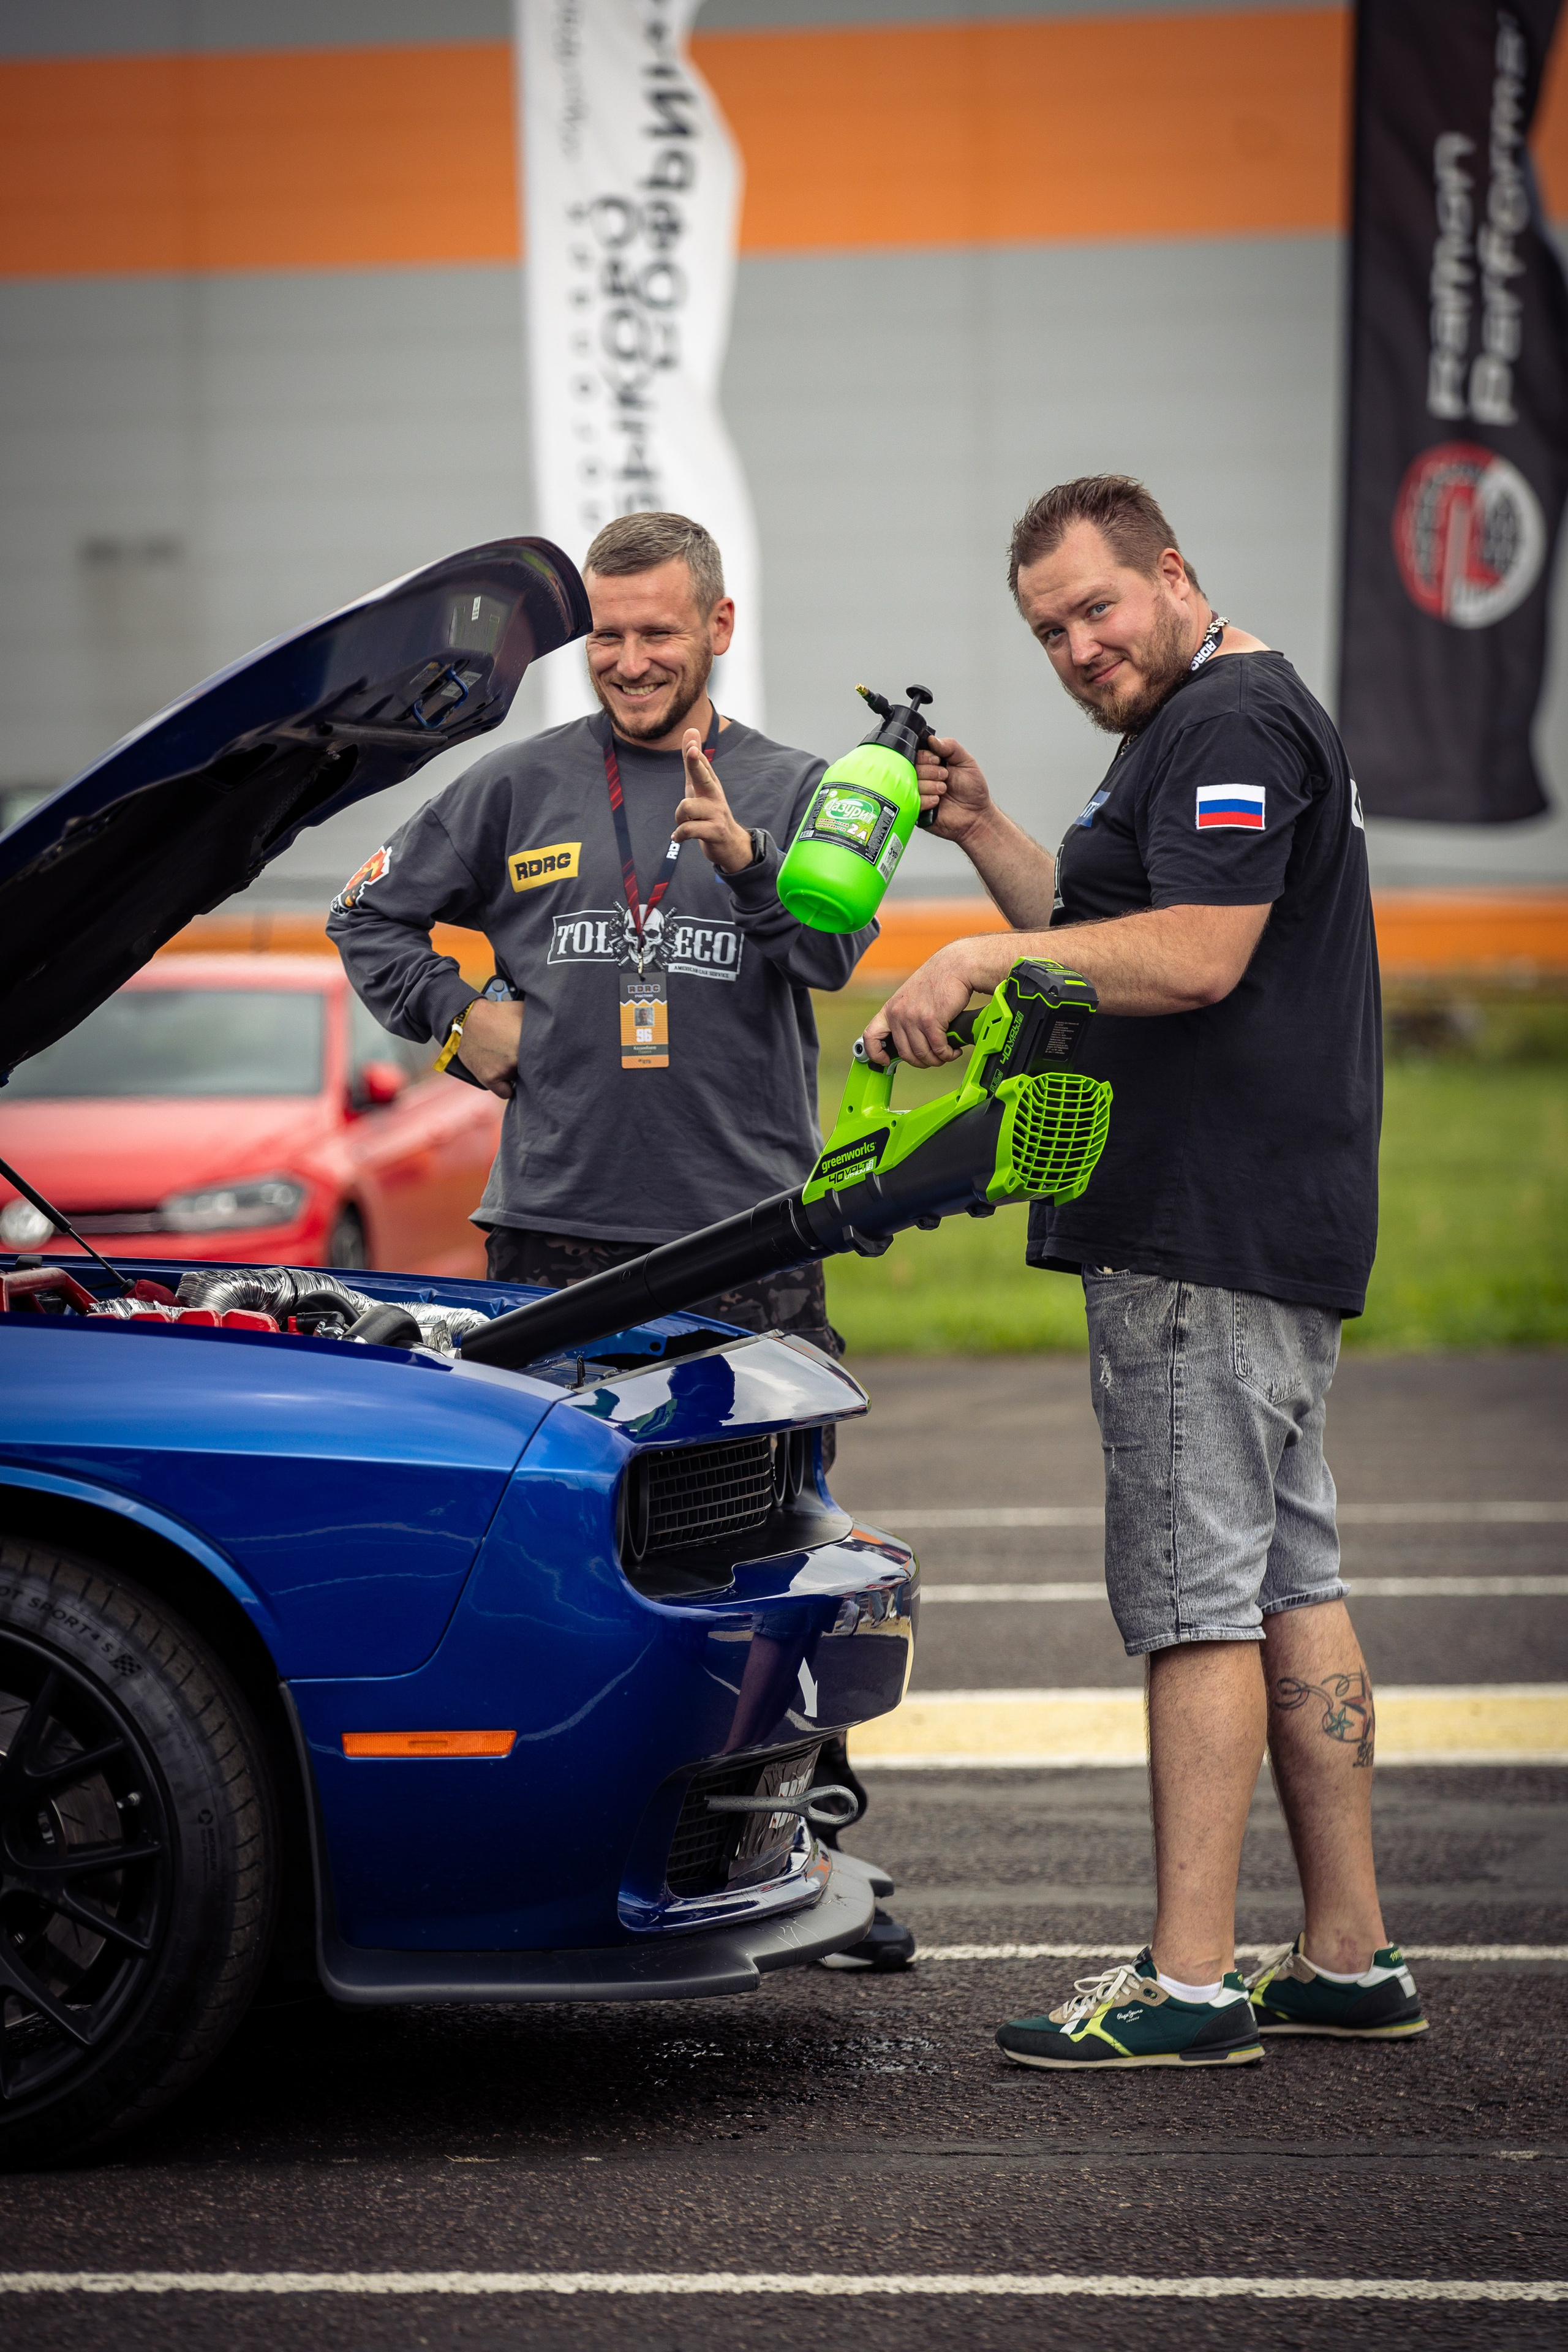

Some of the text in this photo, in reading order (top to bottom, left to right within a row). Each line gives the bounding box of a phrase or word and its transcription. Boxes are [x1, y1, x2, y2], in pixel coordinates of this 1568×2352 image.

[823, 797, 878, 824] Лазурит
[666, 840, 680, 860] RD
[514, 852, 571, 881] RDRC
[627, 984, 661, 993] RDRC
[636, 1028, 652, 1042] 96
[821, 1142, 876, 1174] greenworks
[28, 1597, 92, 1634] SPORT
[208, 1828, 217, 1871] MICHELIN
